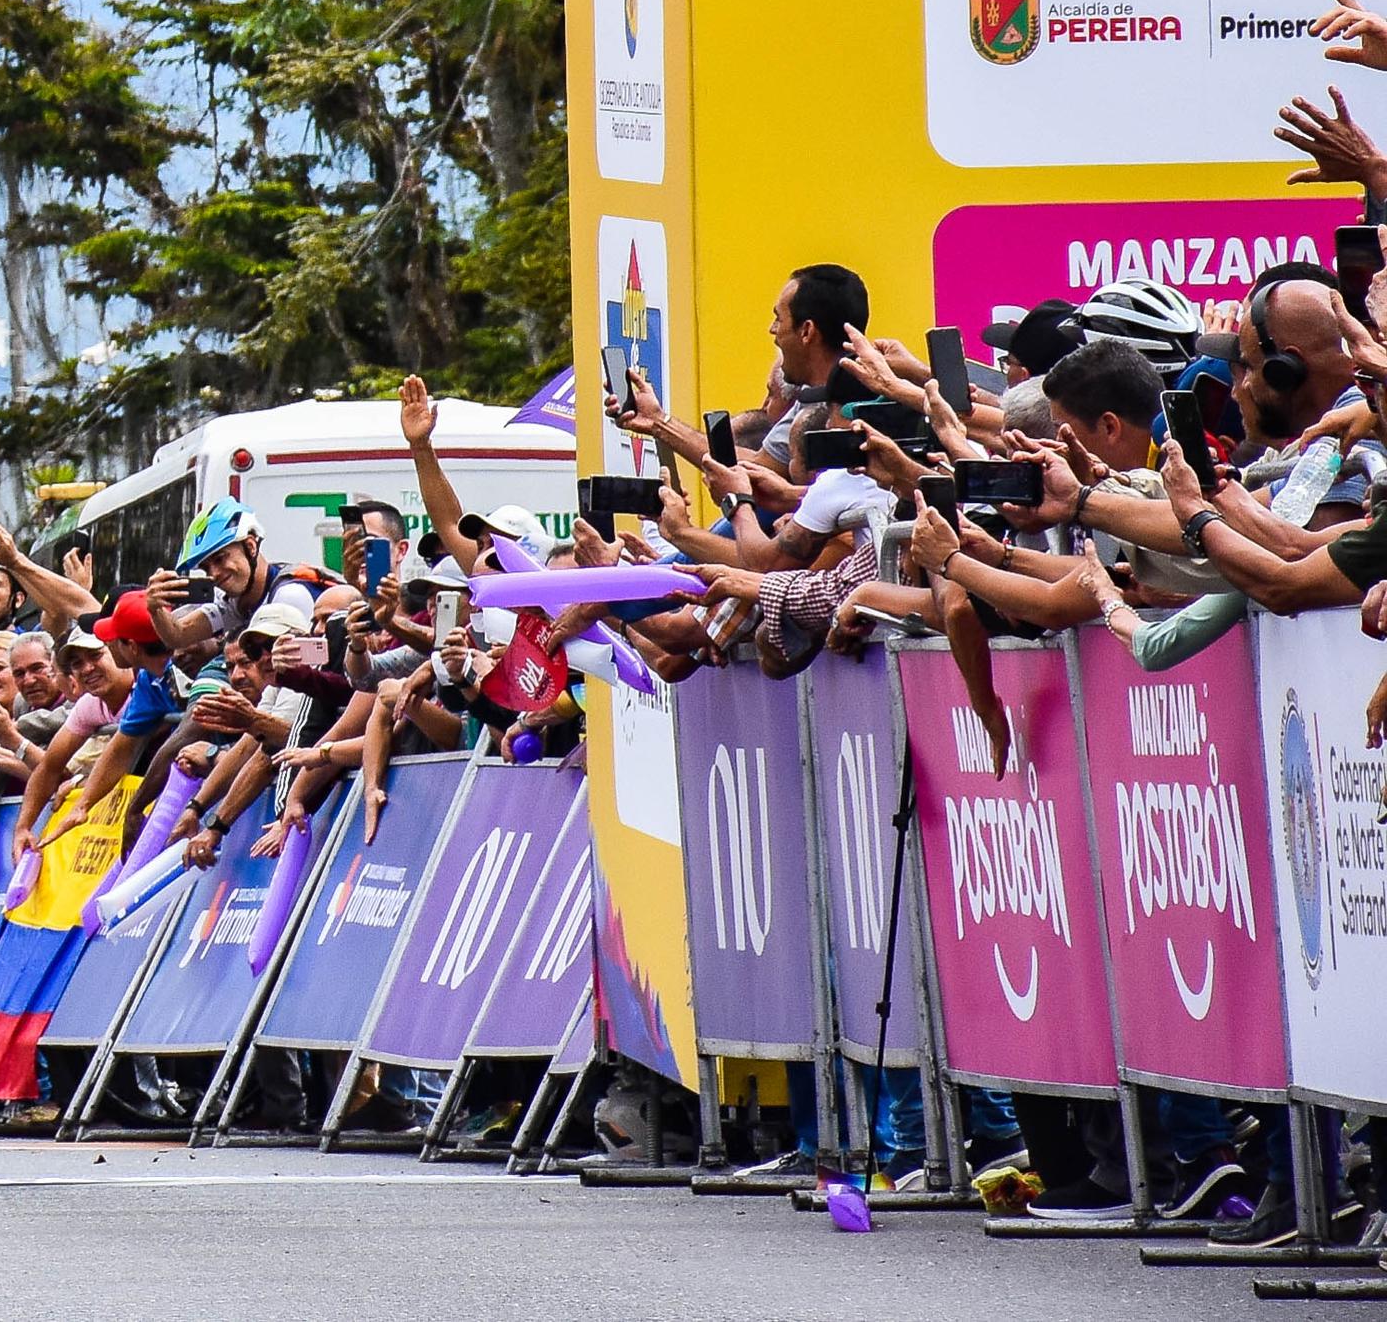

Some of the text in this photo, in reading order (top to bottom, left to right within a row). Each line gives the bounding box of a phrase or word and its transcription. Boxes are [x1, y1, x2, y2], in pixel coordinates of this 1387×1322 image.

[1048, 3, 1134, 17] Alcaldía de
[1048, 16, 1182, 43] PEREIRA
[1128, 684, 1201, 756] MANZANA
[1336, 813, 1384, 870] de Norte
[1340, 878, 1387, 938] Santand
